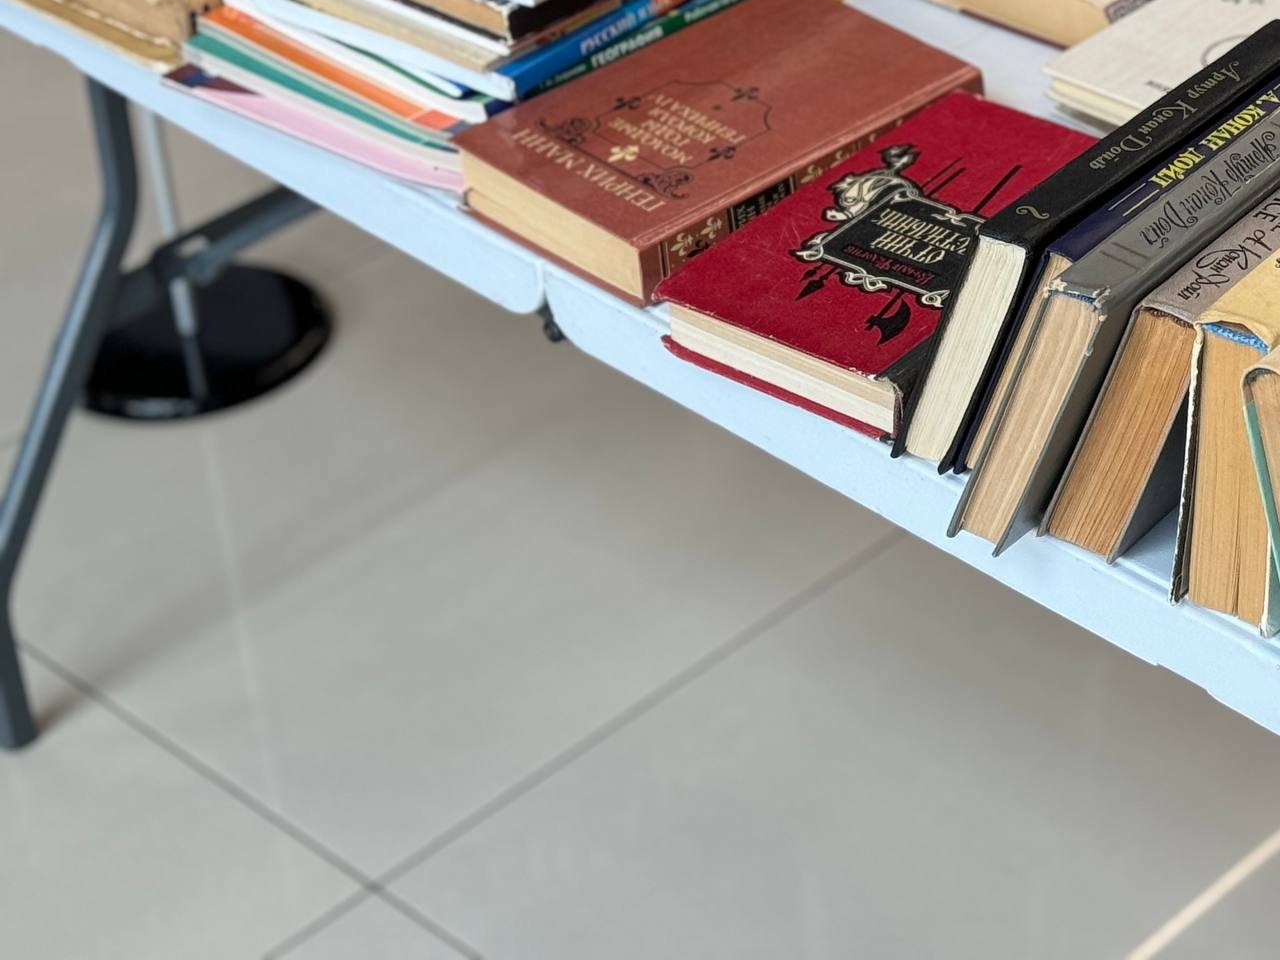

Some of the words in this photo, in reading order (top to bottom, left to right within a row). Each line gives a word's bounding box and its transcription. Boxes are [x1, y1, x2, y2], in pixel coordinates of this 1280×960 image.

[590, 26, 663, 68] ГЕОГРАФИЯ
[1188, 61, 1240, 101] Артур
[640, 120, 691, 148] ГОДЫ
[648, 108, 717, 145] КОРОЛЯ
[667, 99, 747, 143] ГЕНРИХА
[1138, 104, 1198, 136] Конан
[1200, 104, 1266, 152] КОНАН
[511, 127, 582, 168] МАНН
[608, 118, 694, 164] МОЛОДЫЕ
[1089, 132, 1152, 171] Дойль
[1149, 146, 1206, 188] ДОЙЛ
[580, 164, 666, 212] ГЕНРИХ
[1182, 169, 1237, 206] Конан
[1138, 202, 1198, 248] Дойл
[1196, 239, 1250, 271] Конан
[1177, 268, 1231, 301] Дойл
